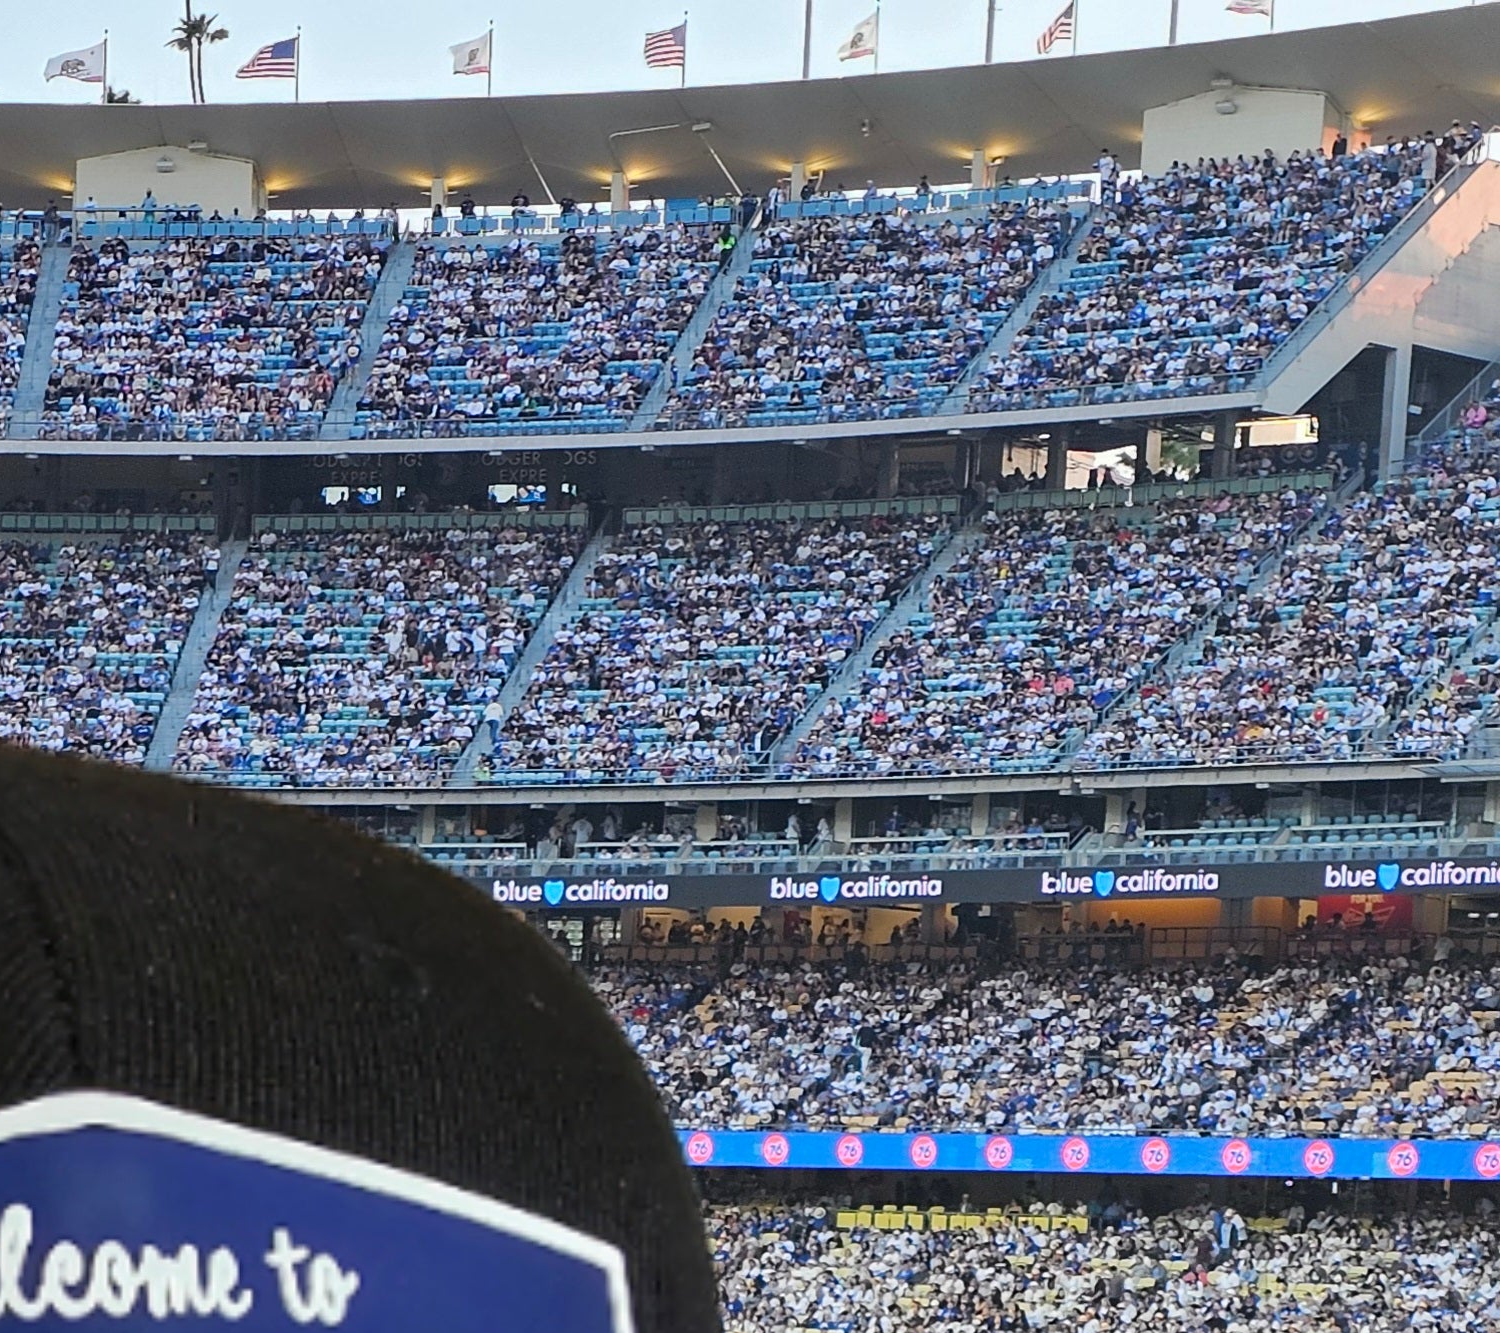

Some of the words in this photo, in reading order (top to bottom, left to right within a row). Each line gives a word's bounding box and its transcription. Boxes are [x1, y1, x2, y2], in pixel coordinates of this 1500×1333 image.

[771, 876, 818, 899] blue
[841, 874, 942, 898] california
[1041, 871, 1093, 894] blue
[1116, 868, 1219, 892] california
[1325, 864, 1376, 888] blue
[1401, 861, 1500, 886] californi
[494, 880, 542, 901] blue
[566, 878, 669, 901] california
[264, 1226, 360, 1326] to
